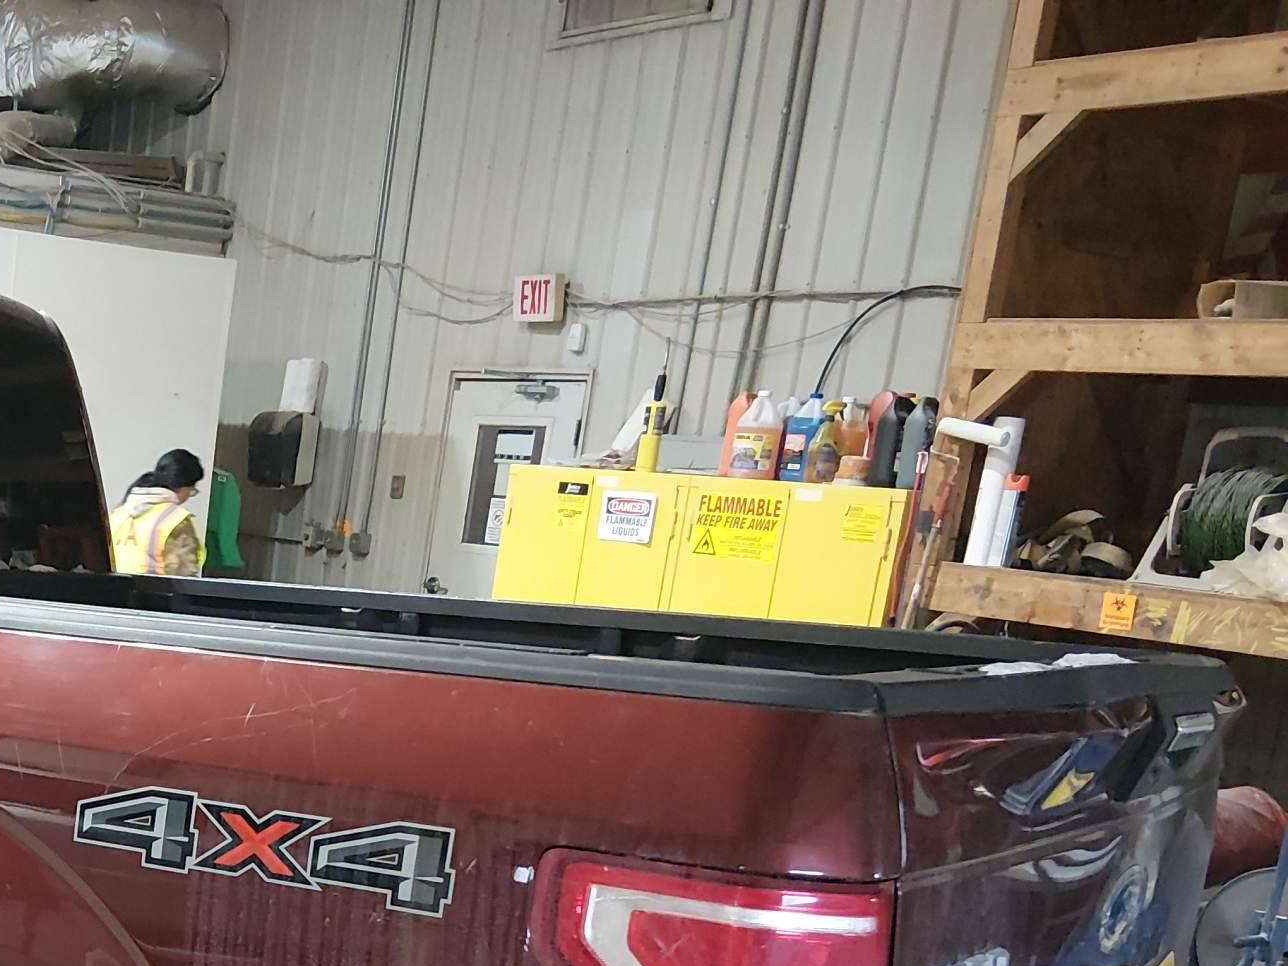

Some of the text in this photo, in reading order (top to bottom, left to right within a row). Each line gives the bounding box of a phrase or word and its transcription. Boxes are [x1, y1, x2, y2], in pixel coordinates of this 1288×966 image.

[520, 279, 551, 315] EXIT
[611, 500, 649, 514] DANGER
[698, 494, 783, 518] FLAMMABLE
[605, 515, 648, 528] FLAMMABLE
[696, 513, 779, 532] KEEP FIRE AWAY
[611, 526, 640, 537] LIQUIDS
